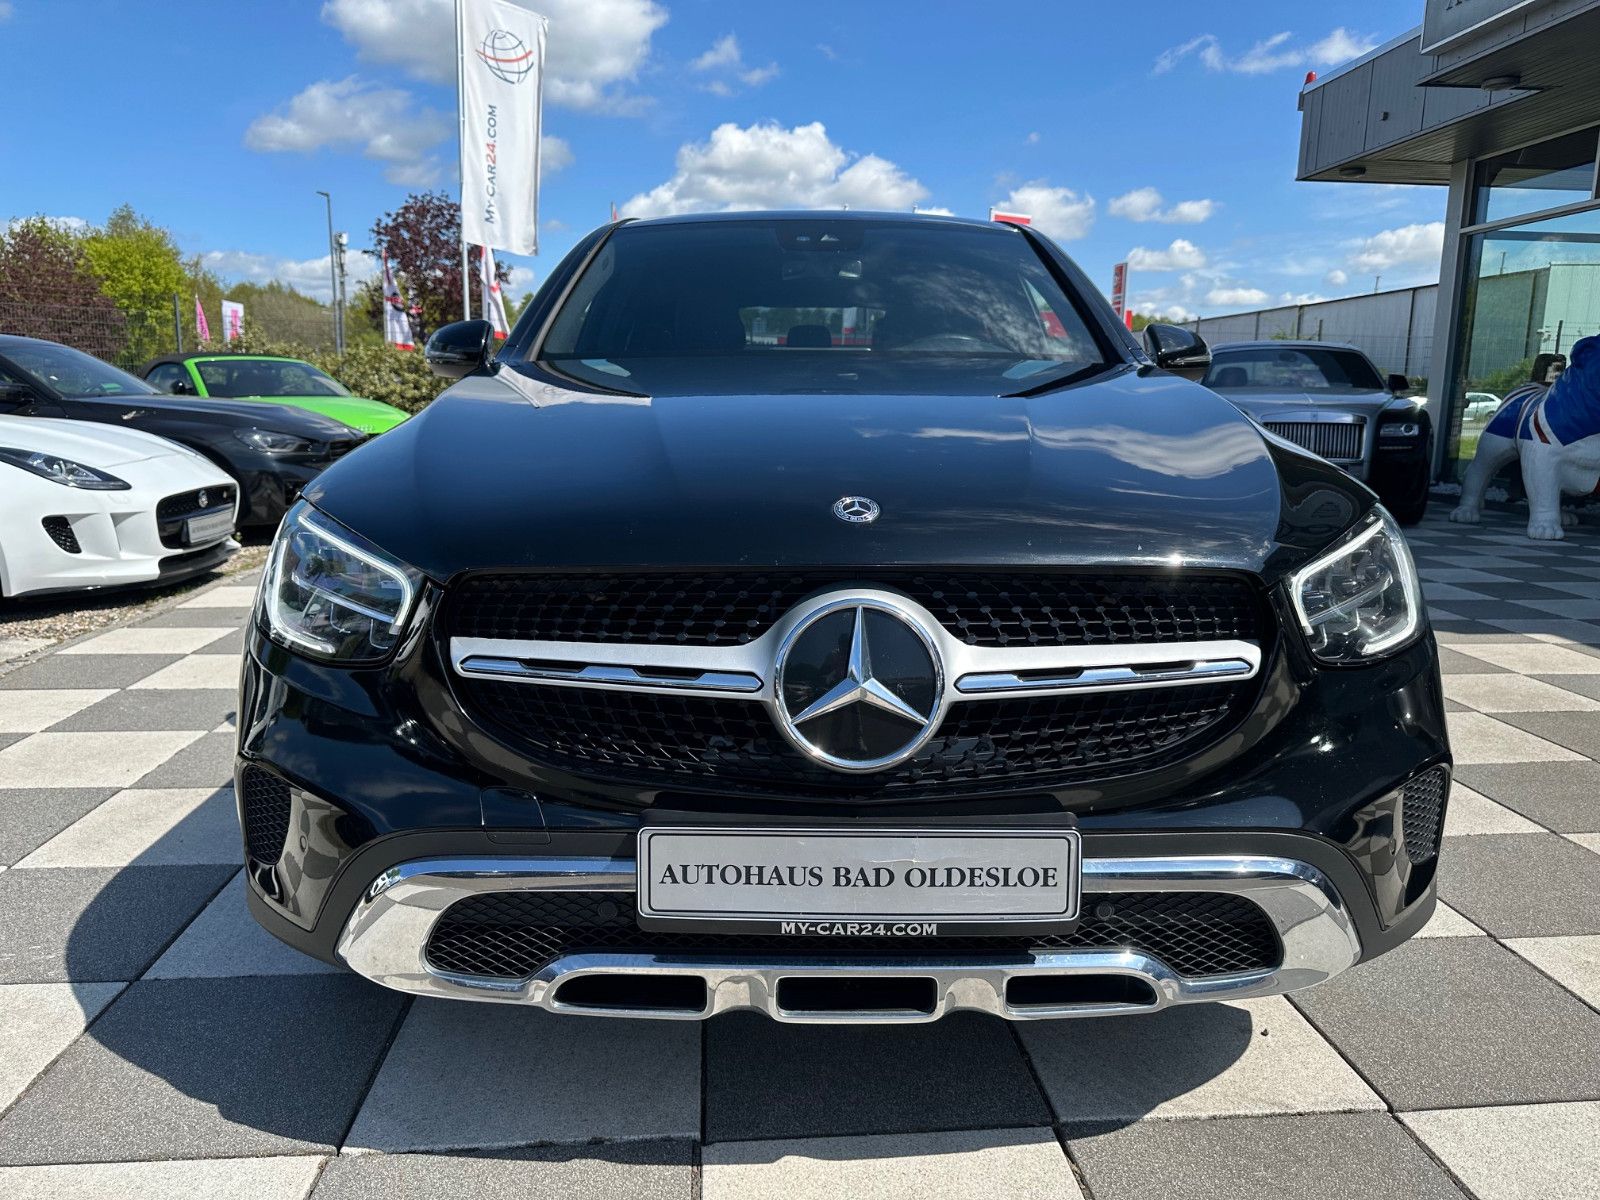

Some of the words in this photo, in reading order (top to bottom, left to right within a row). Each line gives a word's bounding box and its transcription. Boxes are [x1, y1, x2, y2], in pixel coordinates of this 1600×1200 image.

[658, 863, 824, 888] AUTOHAUS
[832, 866, 895, 889] BAD
[903, 866, 1059, 889] OLDESLOE
[780, 920, 938, 937] MY-CAR24.COM
